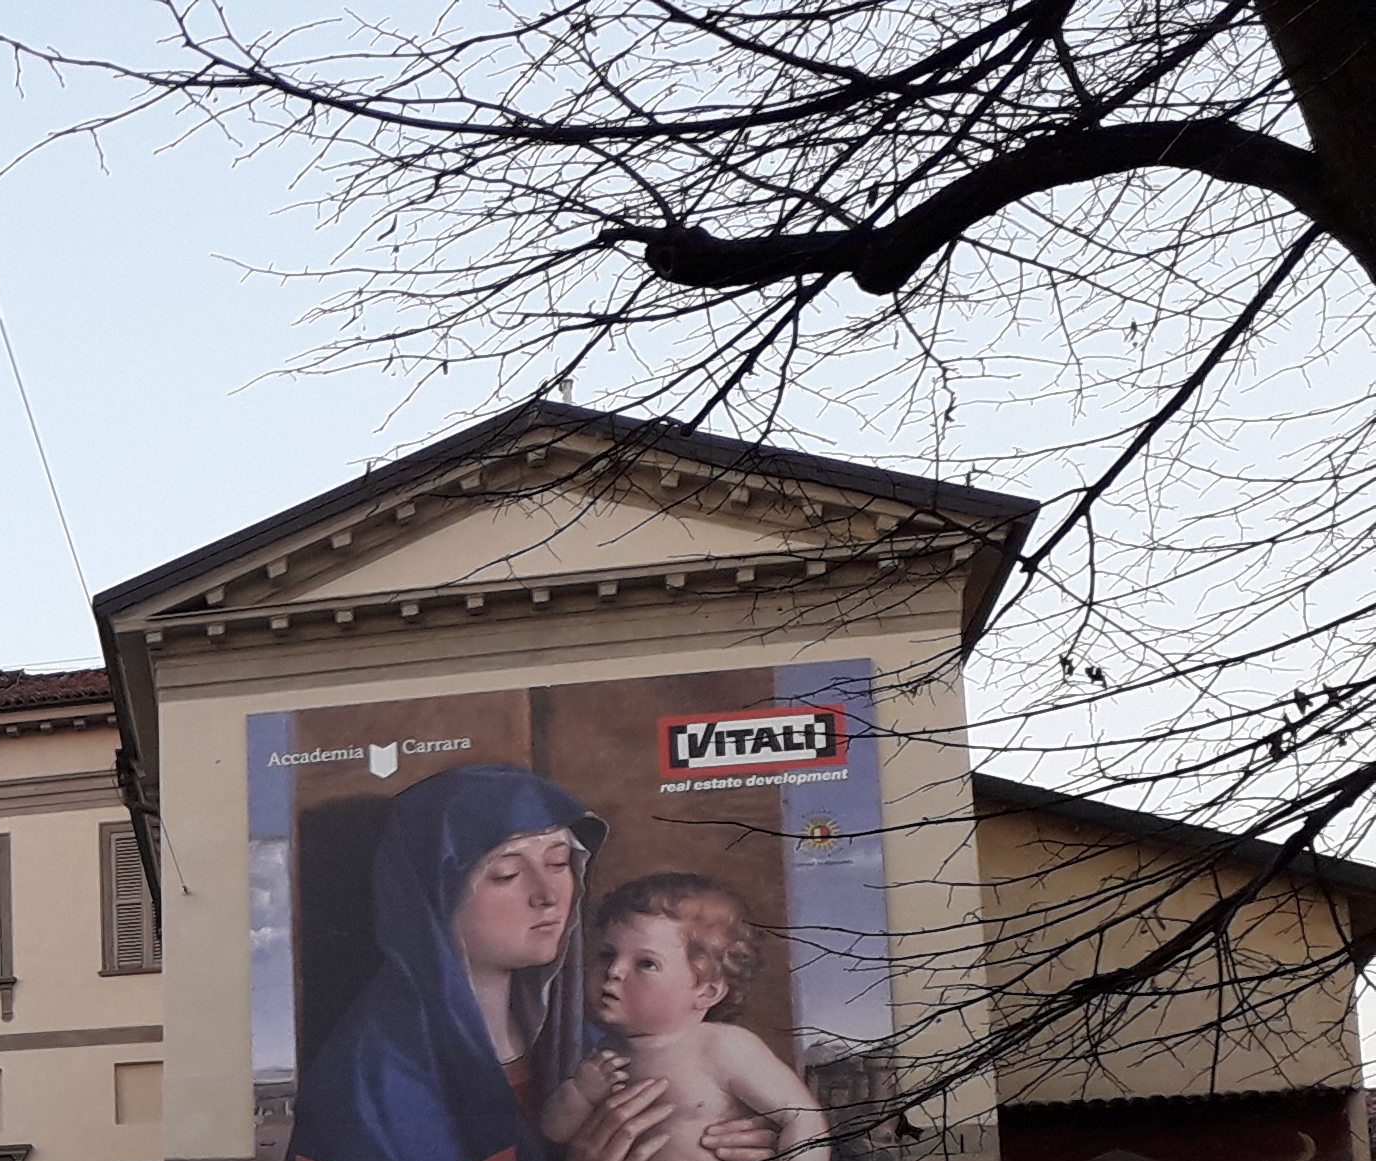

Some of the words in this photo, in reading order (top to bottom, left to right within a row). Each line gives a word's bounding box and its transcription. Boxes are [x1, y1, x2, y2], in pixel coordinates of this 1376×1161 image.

[267, 744, 365, 768] Accademia
[402, 737, 472, 755] Carrara
[659, 779, 691, 794] real
[693, 775, 743, 791] estate
[745, 768, 849, 787] development
